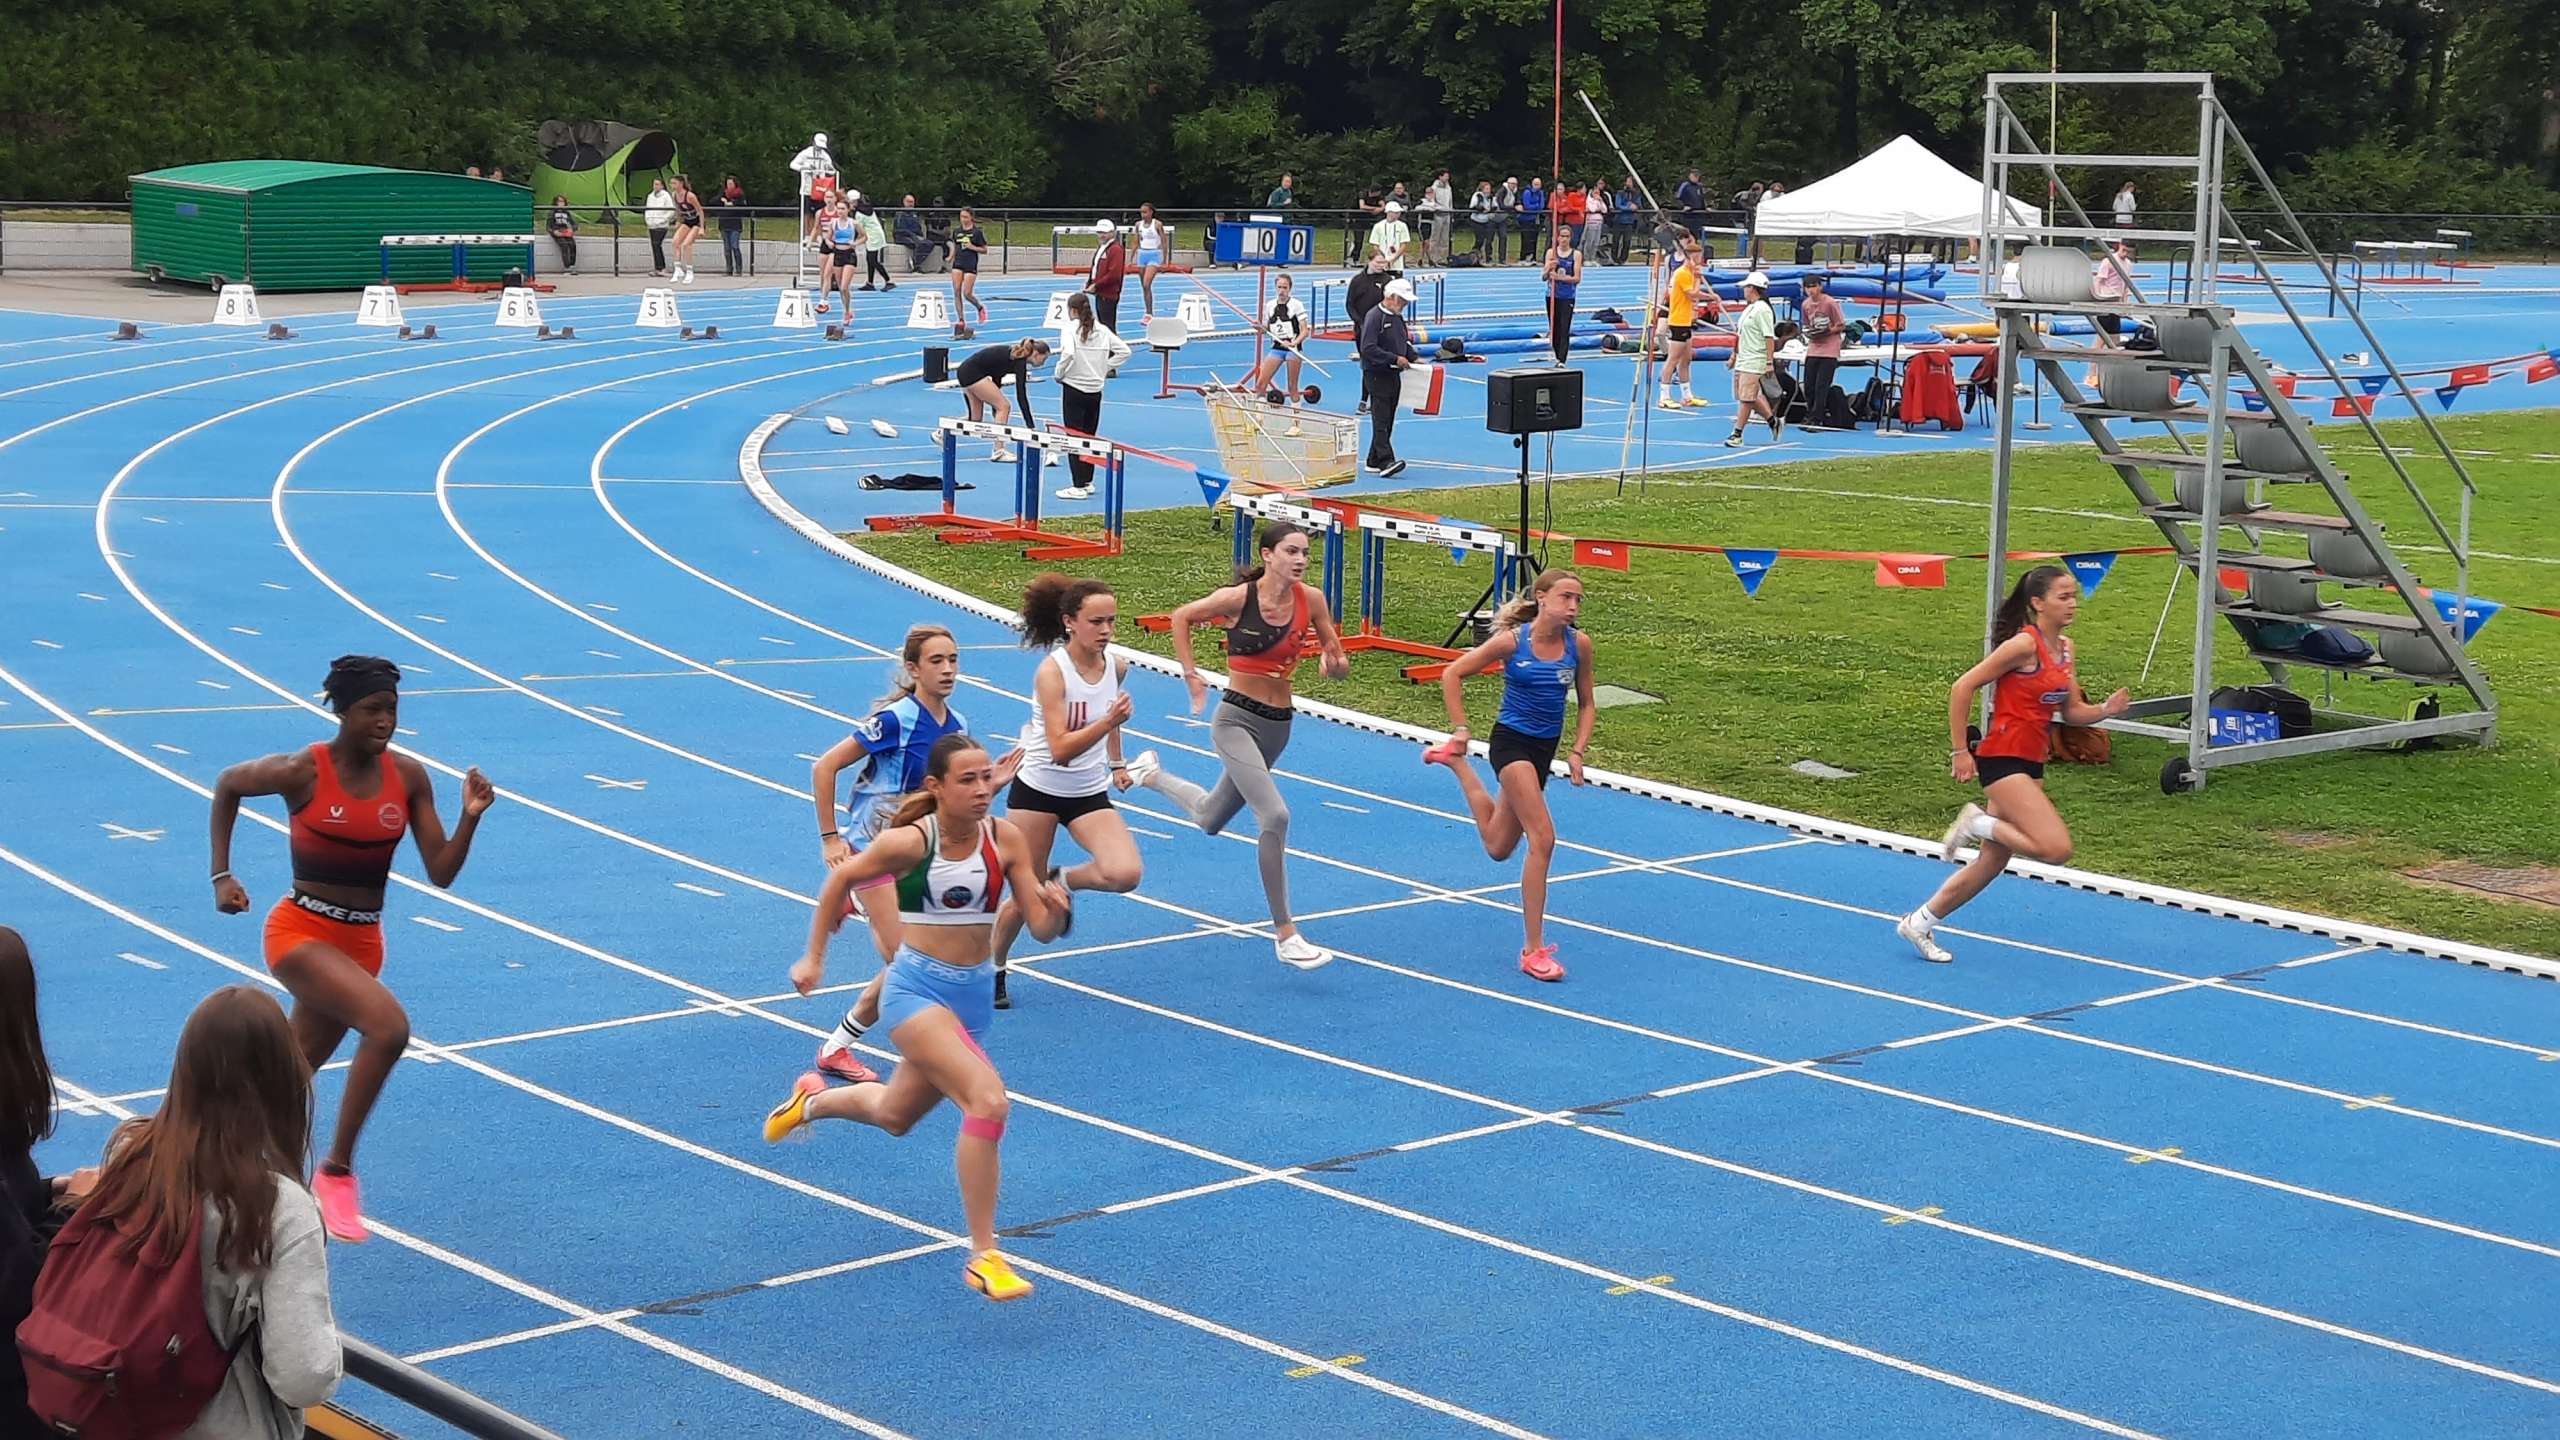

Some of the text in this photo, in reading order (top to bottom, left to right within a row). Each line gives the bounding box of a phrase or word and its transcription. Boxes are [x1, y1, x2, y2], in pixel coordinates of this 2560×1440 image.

[1261, 229, 1304, 254] 0 0
[226, 299, 235, 315] 8
[369, 300, 378, 316] 7
[507, 300, 516, 316] 6
[527, 300, 534, 316] 6
[648, 302, 657, 317] 5
[785, 303, 794, 318] 4
[804, 303, 810, 318] 4
[919, 303, 928, 319] 3
[937, 304, 943, 320] 3
[1054, 304, 1063, 320] 2
[1185, 306, 1191, 320] 1
[1202, 306, 1208, 321] 1
[297, 895, 349, 920] NIKE
